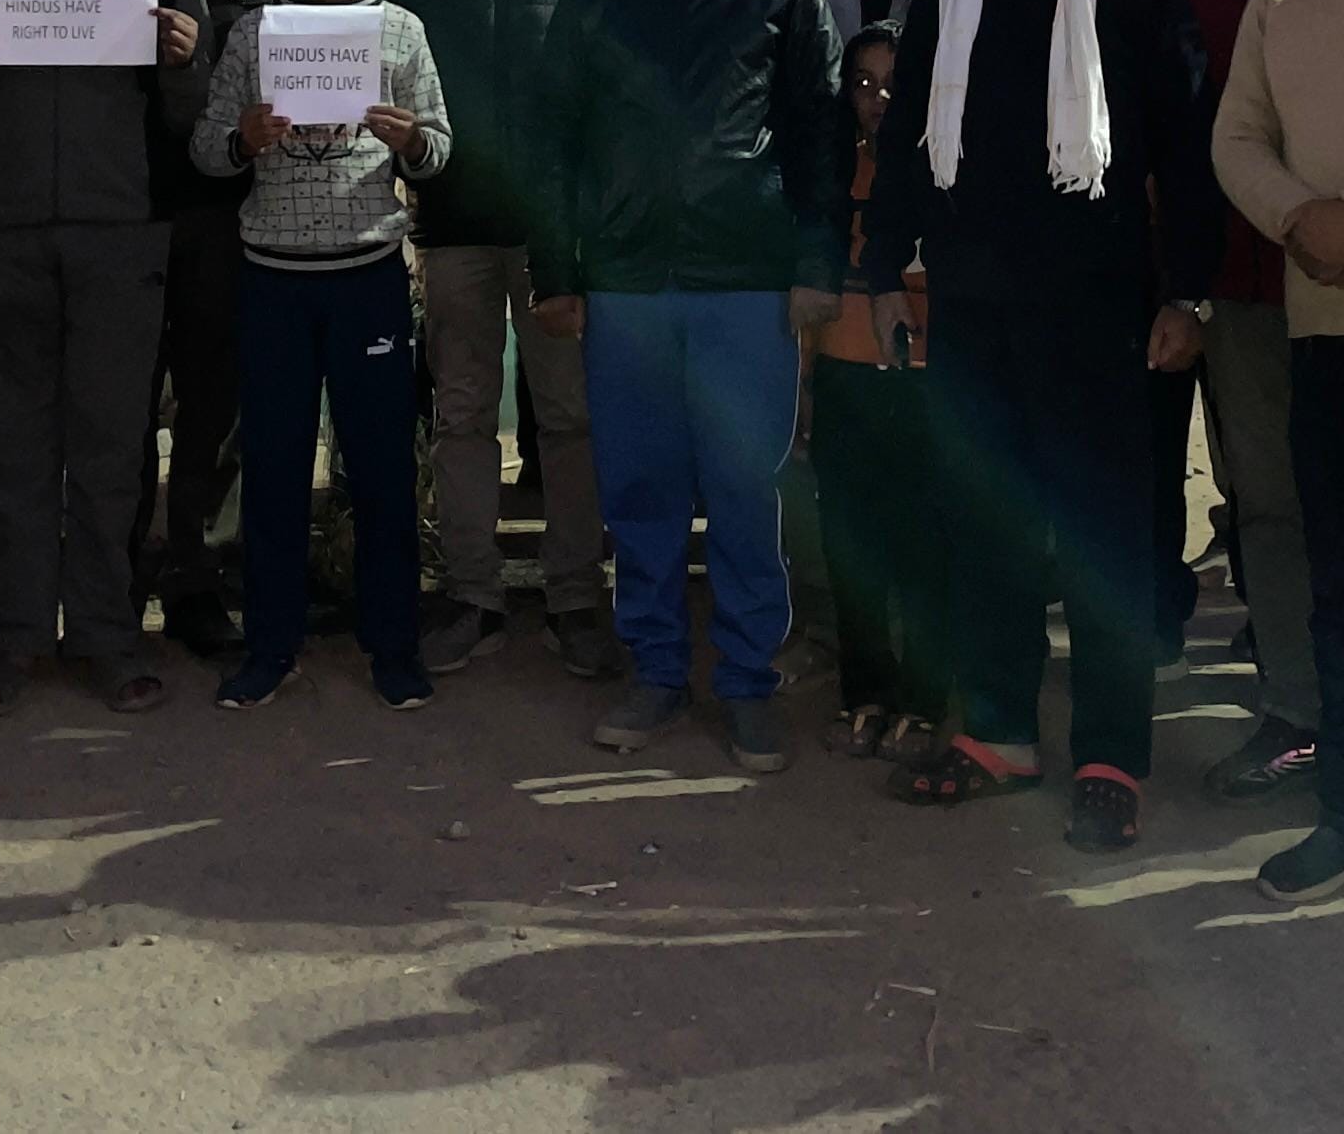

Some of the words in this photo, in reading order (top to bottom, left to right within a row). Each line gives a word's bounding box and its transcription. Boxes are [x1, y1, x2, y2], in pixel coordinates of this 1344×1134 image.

[5, 0, 61, 14] HINDUS
[65, 0, 102, 14] HAVE
[12, 25, 48, 40] RIGHT
[52, 25, 68, 40] TO
[71, 25, 95, 40] LIVE
[269, 48, 326, 63] HINDUS
[330, 48, 370, 64] HAVE
[274, 75, 313, 90] RIGHT
[316, 75, 333, 91] TO
[336, 76, 363, 91] LIVE
